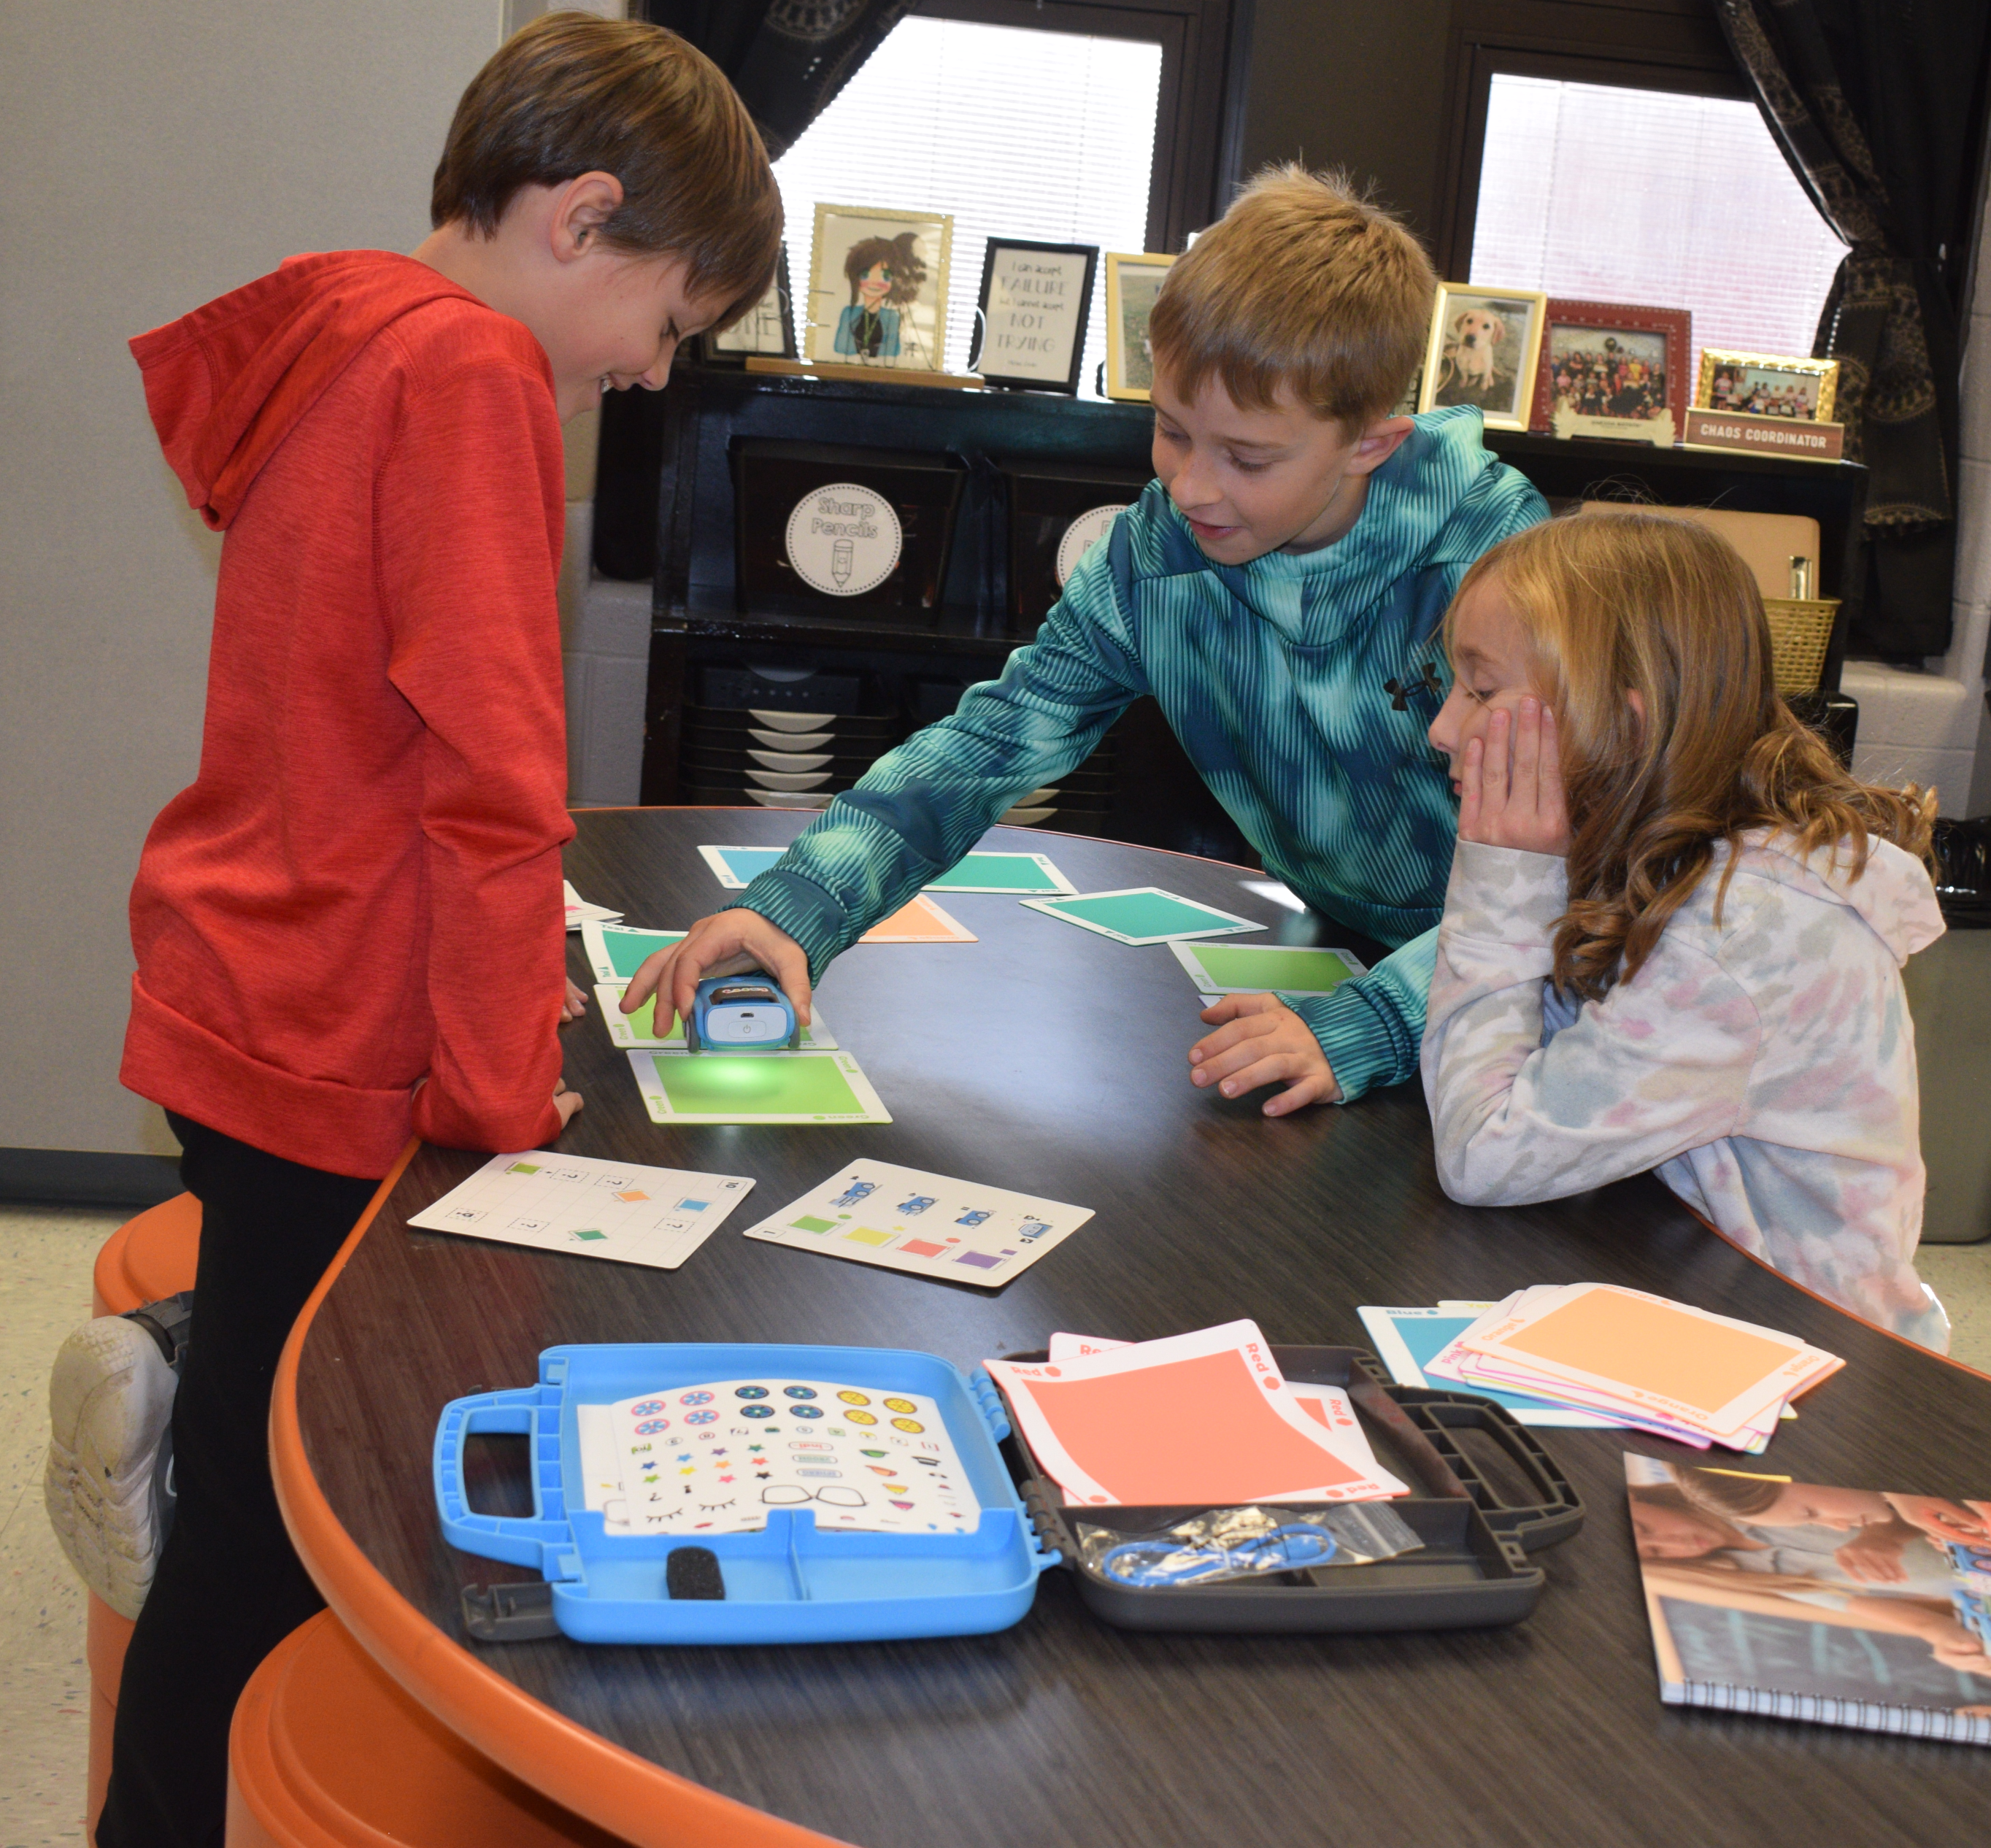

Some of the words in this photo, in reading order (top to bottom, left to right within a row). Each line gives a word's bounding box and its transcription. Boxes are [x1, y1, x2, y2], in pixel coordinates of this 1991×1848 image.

[1035, 264, 1062, 276] accept
[1001, 275, 1069, 296] FAILURE
[1010, 313, 1045, 329] NOT
[997, 334, 1055, 353] TRYING
[1700, 423, 1741, 439] CHAOS
[1744, 428, 1827, 448] COORDINATOR
[818, 497, 876, 520] Sharp
[811, 517, 878, 539] Pencils
[1481, 1321, 1517, 1341] Orange
[1080, 1344, 1104, 1355] Re
[1245, 1342, 1270, 1373] Red
[1441, 1350, 1463, 1365] Pink
[1010, 1366, 1043, 1377] Red
[1329, 1398, 1347, 1417] Red
[1647, 1395, 1709, 1420] Orange
[1345, 1483, 1381, 1494] Red
